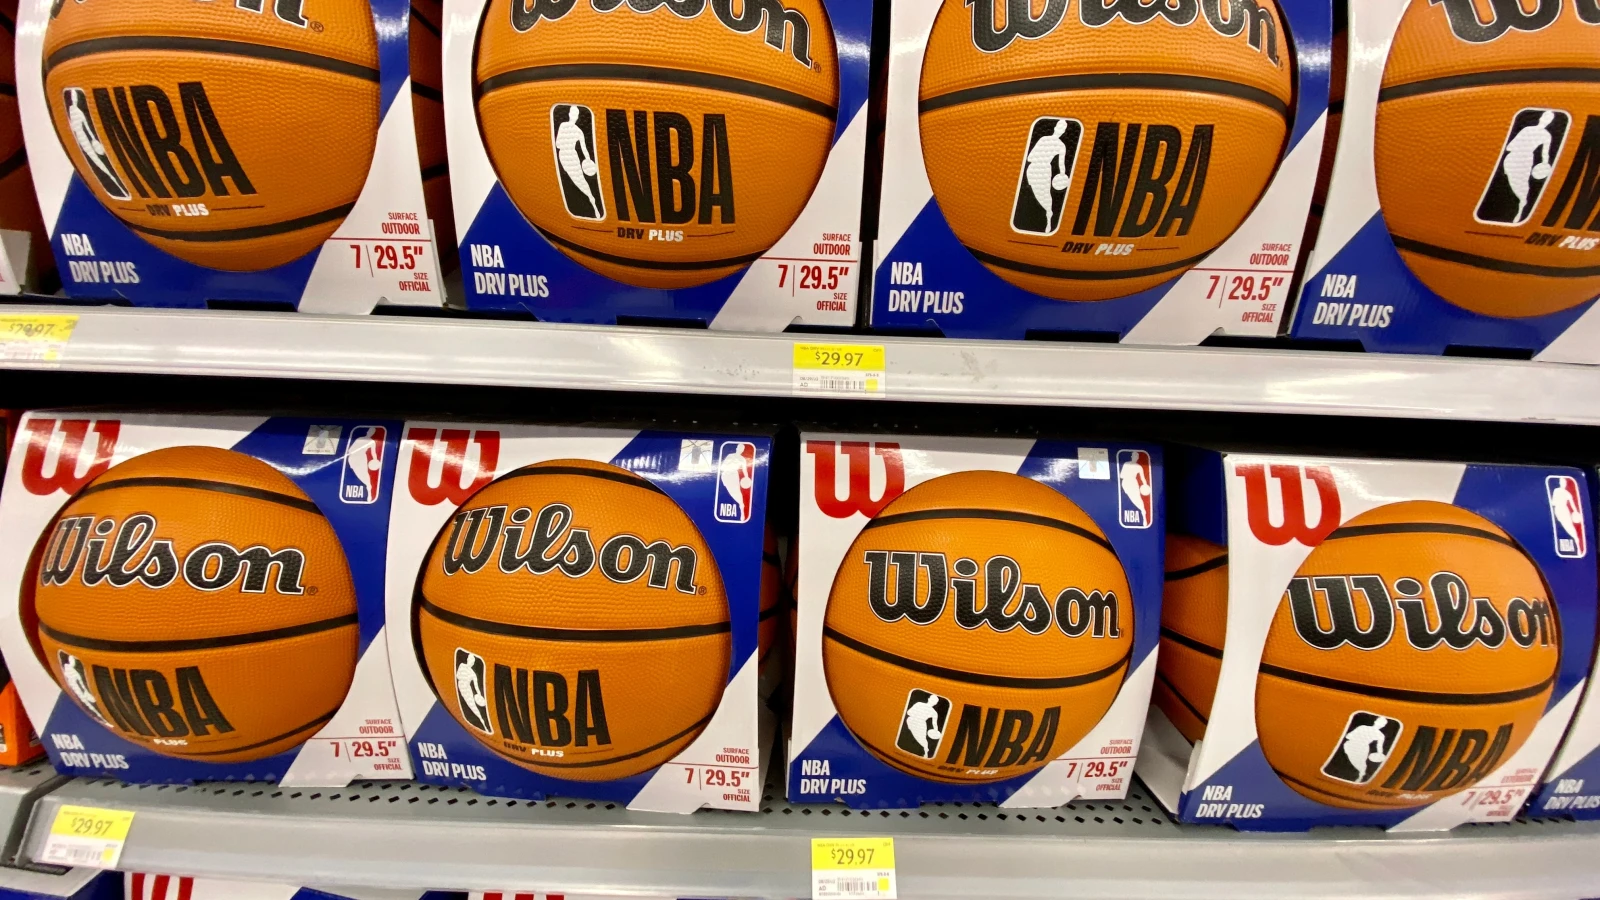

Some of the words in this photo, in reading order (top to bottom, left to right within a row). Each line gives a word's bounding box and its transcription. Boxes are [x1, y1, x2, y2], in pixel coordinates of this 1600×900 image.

[91, 81, 258, 199] NBA
[605, 109, 735, 224] NBA
[1071, 122, 1215, 238] NBA
[146, 204, 171, 216] DRV
[172, 204, 209, 216] PLUS
[388, 212, 418, 220] SURFACE
[382, 223, 420, 234] OUTDOOR
[617, 227, 644, 239] DRV
[648, 229, 684, 241] PLUS
[822, 233, 851, 241] SURFACE
[61, 234, 95, 256] NBA
[813, 243, 850, 255] OUTDOOR
[1061, 242, 1095, 254] DRV
[1095, 244, 1135, 255] PLUS
[1261, 243, 1292, 251] SURFACE
[1525, 232, 1562, 246] DRV
[1558, 235, 1600, 250] PLUS
[350, 245, 361, 268] 7
[374, 245, 423, 269] 29.5"
[470, 244, 505, 268] NBA
[1249, 253, 1289, 265] OUTDOOR
[69, 261, 100, 282] DRV
[100, 261, 140, 283] PLUS
[778, 264, 788, 288] 7
[800, 265, 849, 290] 29.5"
[890, 262, 923, 285] NBA
[399, 281, 431, 291] OFFICIAL
[474, 272, 505, 295] DRV
[508, 274, 549, 297] PLUS
[1206, 275, 1220, 299] 7
[1228, 276, 1284, 300] 29.5"
[1320, 274, 1356, 298] NBA
[817, 301, 846, 311] OFFICIAL
[888, 290, 921, 312] DRV
[923, 292, 964, 314] PLUS
[1242, 312, 1273, 322] OFFICIAL
[1312, 303, 1350, 326] DRV
[1347, 304, 1394, 328] PLUS
[815, 351, 864, 366] $29.97
[346, 485, 364, 498] NBA
[720, 503, 737, 517] NBA
[1235, 464, 1342, 547] W
[1124, 510, 1140, 523] NBA
[41, 513, 306, 595] Wilson
[443, 503, 698, 594] Wilson
[863, 550, 1121, 639] Wilson
[1284, 572, 1555, 651] Wilson
[93, 665, 236, 738] NBA
[494, 663, 612, 747] NBA
[359, 726, 394, 734] OUTDOOR
[947, 704, 1061, 767] NBA
[51, 734, 84, 750] NBA
[330, 742, 340, 757] 7
[352, 741, 396, 757] 29.5"
[418, 742, 447, 759] NBA
[1100, 746, 1131, 754] OUTDOOR
[60, 752, 91, 767] DRV
[92, 754, 129, 769] PLUS
[531, 748, 564, 757] PLUS
[715, 754, 750, 764] OUTDOOR
[1380, 722, 1514, 791] NBA
[422, 760, 450, 776] DRV
[451, 763, 486, 780] PLUS
[801, 760, 830, 775] NBA
[1067, 763, 1077, 778] 7
[1084, 761, 1128, 777] 29.5"
[685, 768, 694, 783] 7
[705, 769, 750, 787] 29.5"
[1554, 779, 1584, 793] NBA
[800, 779, 828, 794] DRV
[831, 779, 866, 794] PLUS
[1202, 785, 1233, 800] NBA
[723, 794, 750, 802] OFFICIAL
[1195, 803, 1229, 817] DRV
[1226, 804, 1264, 818] PLUS
[71, 817, 114, 836] $29.97
[831, 848, 875, 865] $29.97
